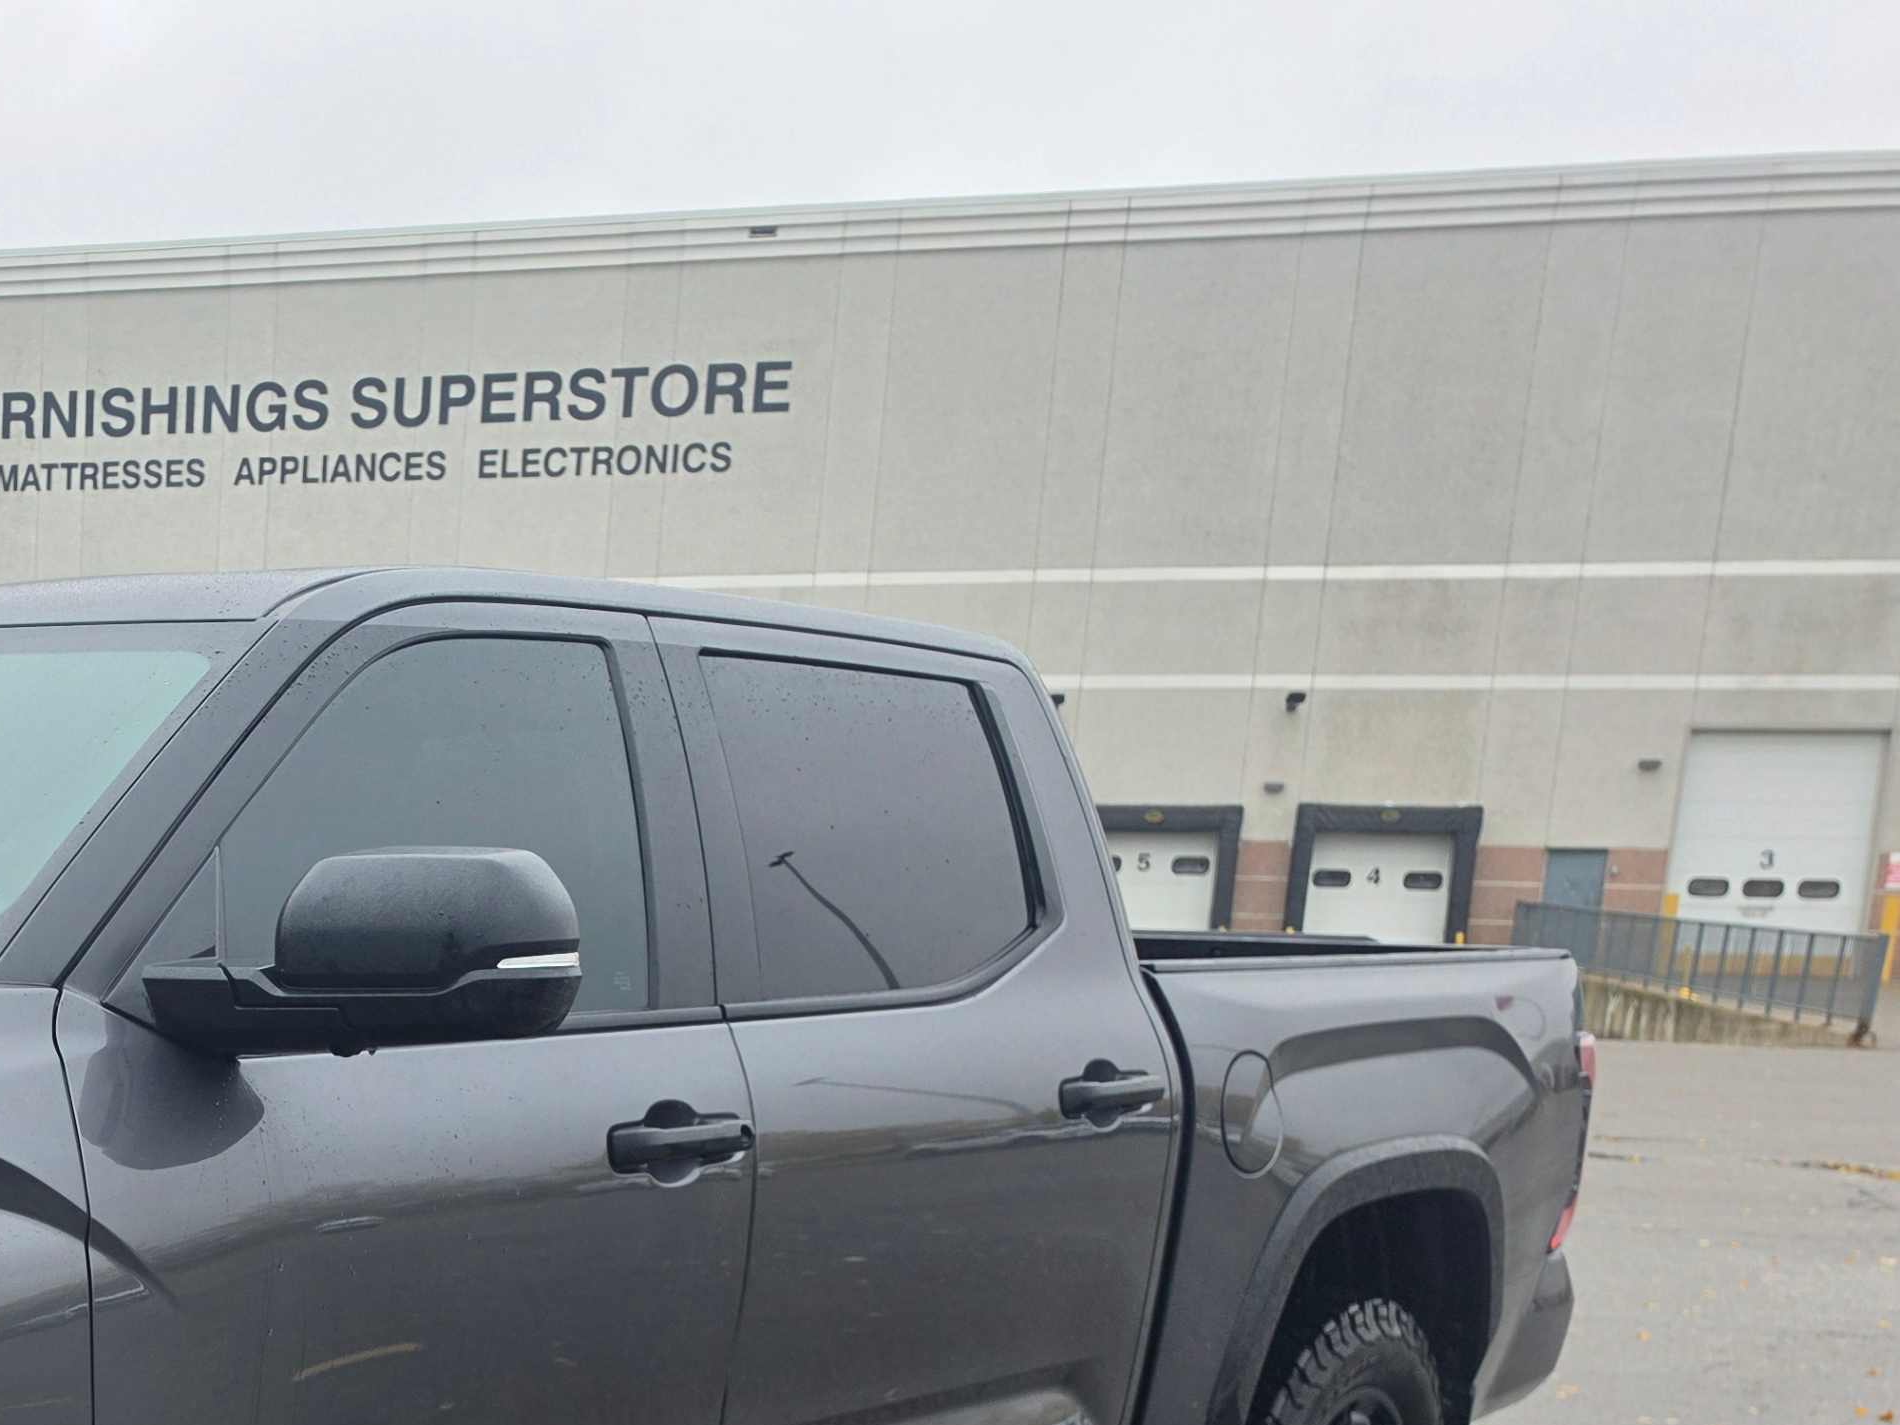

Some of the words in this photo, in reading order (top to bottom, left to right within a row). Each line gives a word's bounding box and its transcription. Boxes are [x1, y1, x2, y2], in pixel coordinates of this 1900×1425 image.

[350, 361, 793, 429] SUPERSTORE
[233, 450, 446, 486] APPLIANCES
[478, 441, 732, 479] ELECTRONICS
[1136, 853, 1151, 872] 5
[1759, 848, 1775, 871] 3
[1366, 866, 1381, 885] 4
